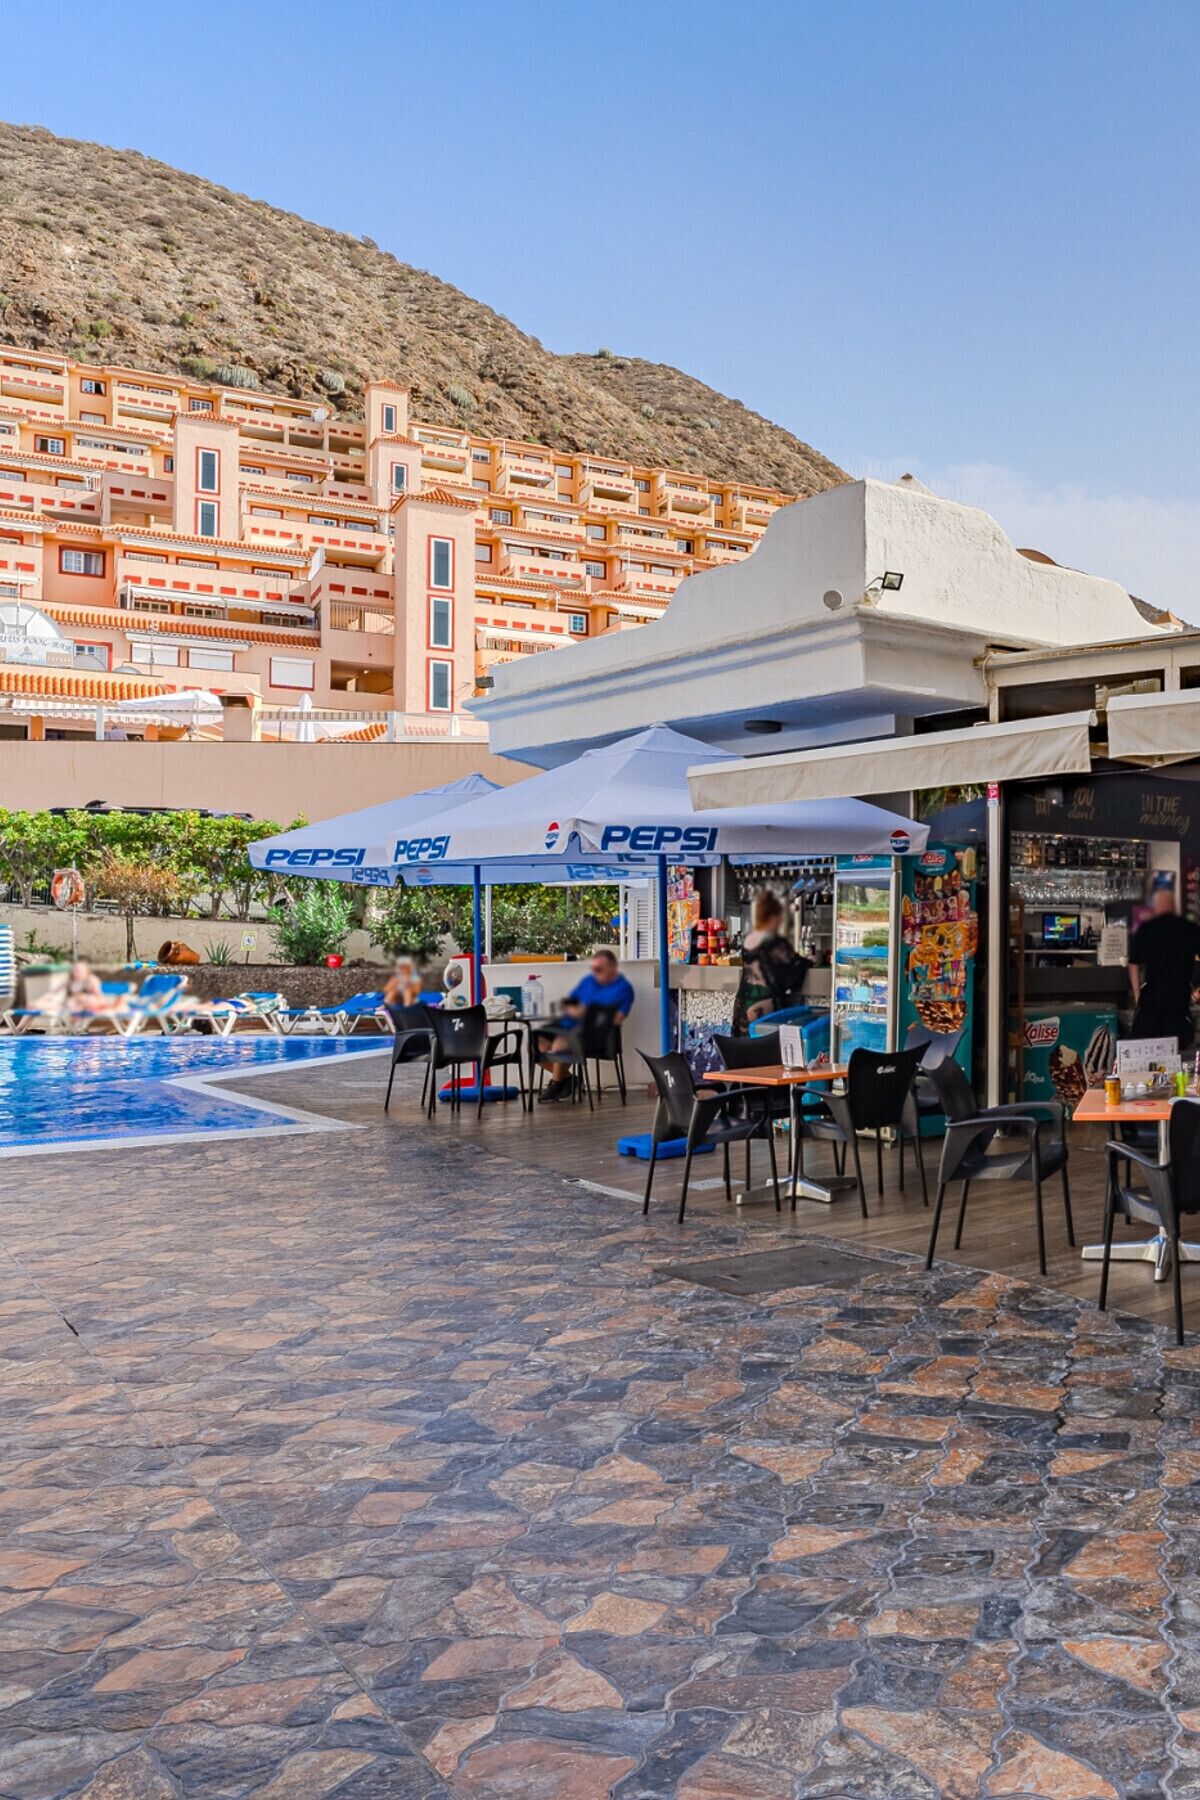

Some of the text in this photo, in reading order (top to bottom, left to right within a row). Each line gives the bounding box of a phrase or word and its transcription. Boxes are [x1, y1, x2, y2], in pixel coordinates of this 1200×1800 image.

[1155, 795, 1182, 813] THE
[394, 836, 451, 863] PEPSI
[601, 826, 718, 851] PEPSI
[265, 848, 366, 867] PEPSI
[1023, 1021, 1060, 1047] Kalise
